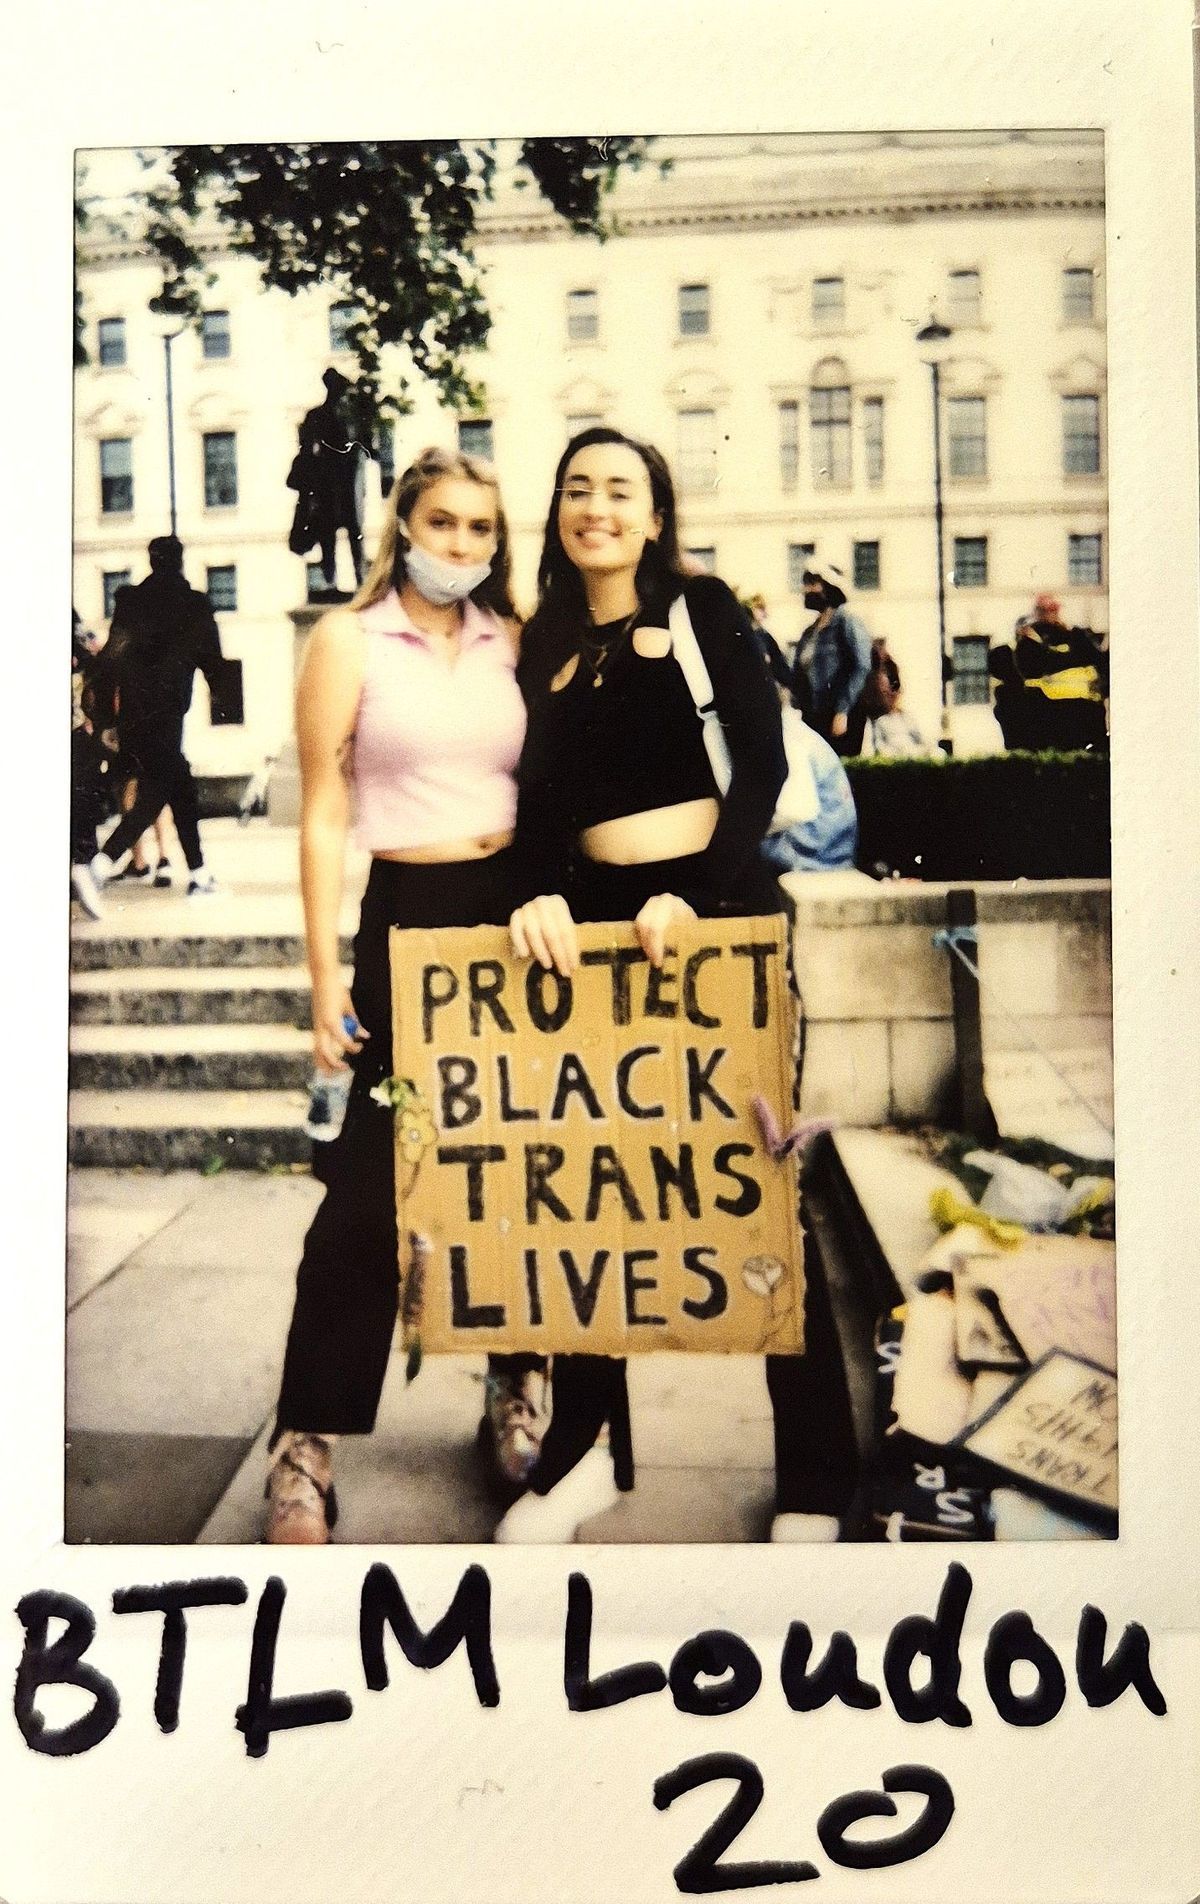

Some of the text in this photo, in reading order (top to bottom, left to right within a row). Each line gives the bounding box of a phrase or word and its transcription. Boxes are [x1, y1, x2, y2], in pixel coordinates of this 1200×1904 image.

[422, 942, 778, 1044] PROTECT
[437, 1046, 736, 1129] BLACK
[437, 1142, 762, 1225] TRANS
[449, 1245, 728, 1329] LIVES
[13, 1562, 1168, 1758] BTLM London
[652, 1752, 956, 1895] 20
